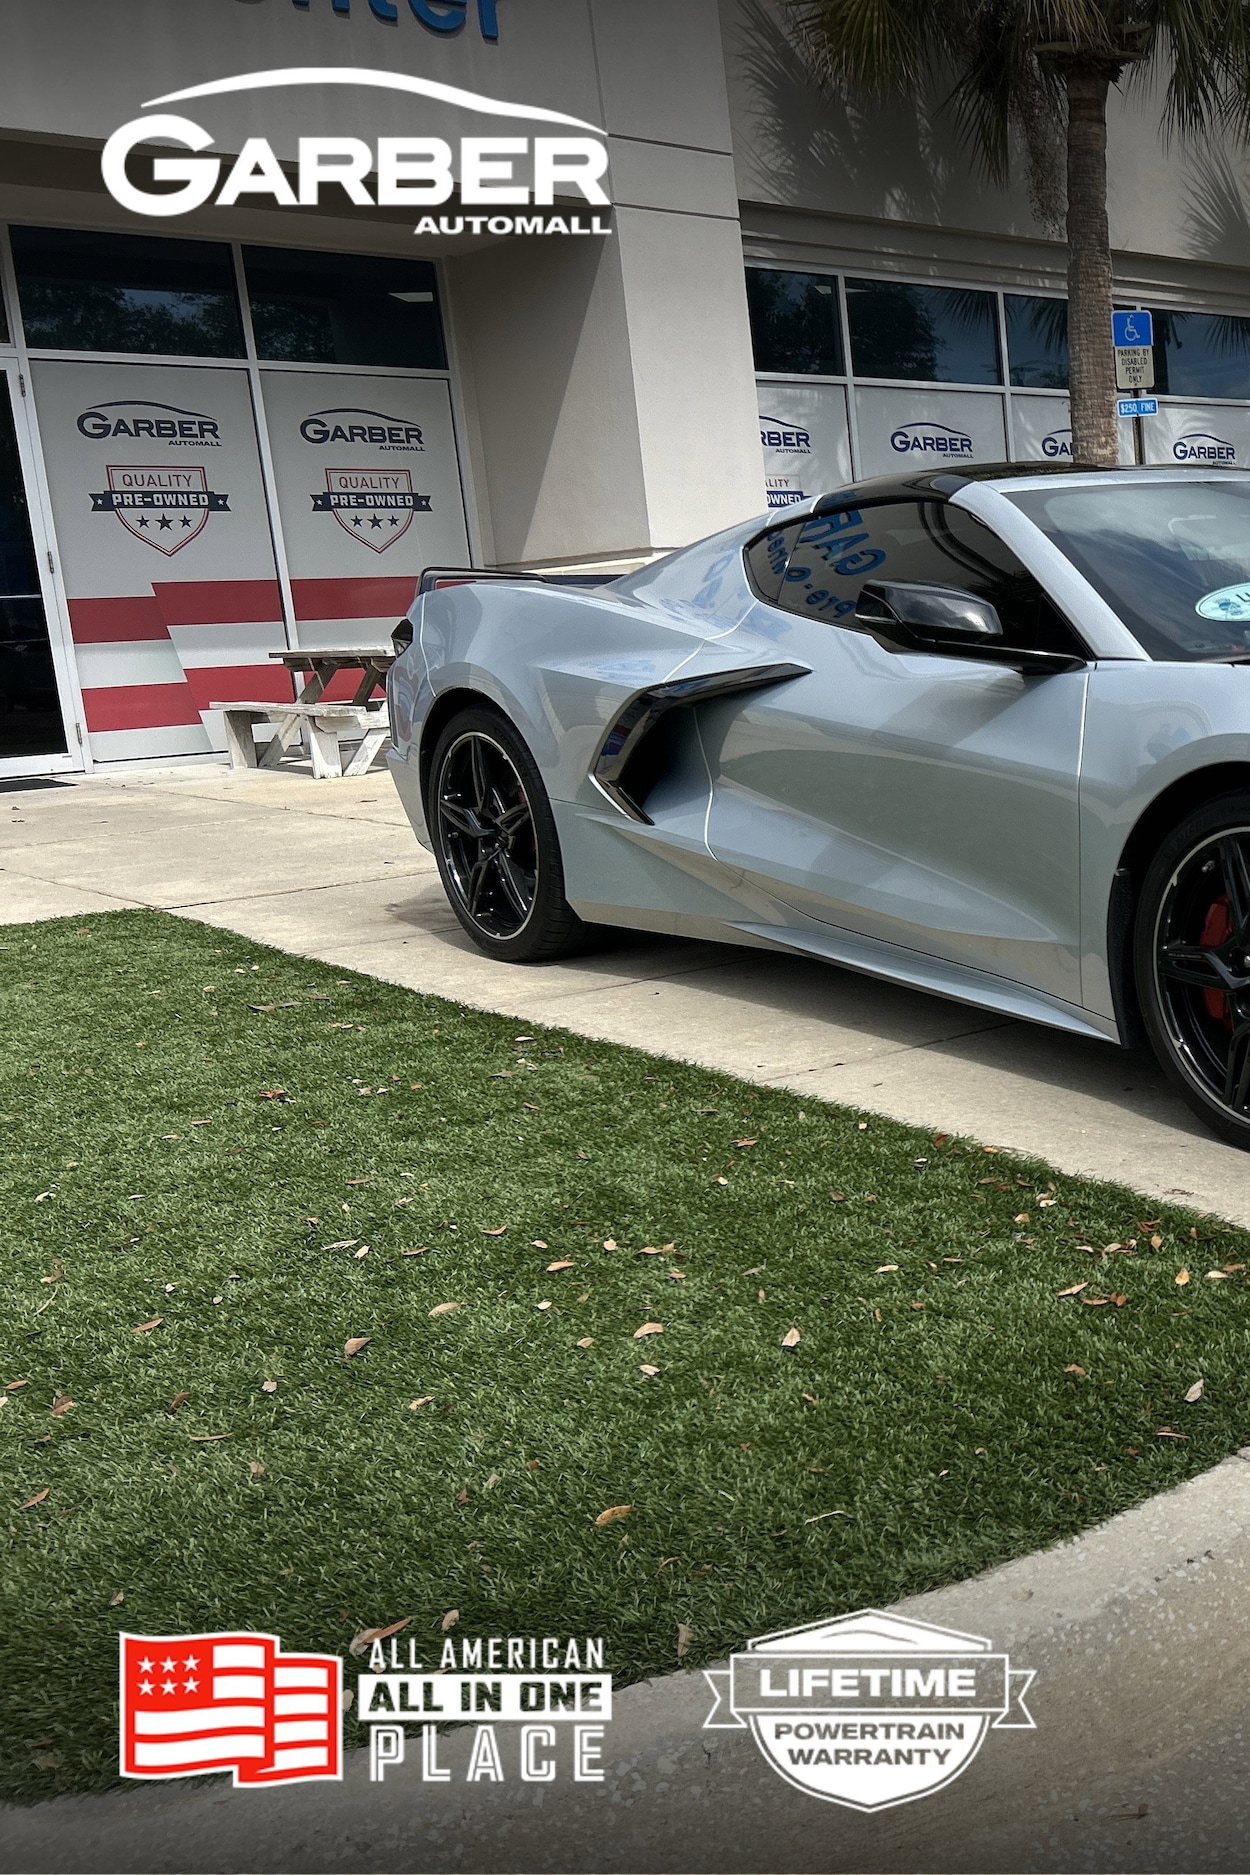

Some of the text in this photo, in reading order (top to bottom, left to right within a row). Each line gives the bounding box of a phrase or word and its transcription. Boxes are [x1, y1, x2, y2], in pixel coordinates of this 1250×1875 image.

[1117, 349, 1150, 357] PARKING BY
[1121, 357, 1148, 366] DISABLED
[1125, 366, 1145, 374] PERMIT
[1128, 375, 1142, 384] ONLY
[1120, 402, 1155, 414] $250 FINE
[77, 411, 222, 439] GARBER
[299, 418, 425, 444] GARBER
[890, 431, 973, 452] GARBER
[1172, 441, 1236, 460] GARBER
[122, 474, 192, 487] QUALITY
[339, 476, 400, 489] QUALITY
[111, 493, 210, 506] PRE-OWNED
[330, 494, 414, 506] PRE-OWNED
